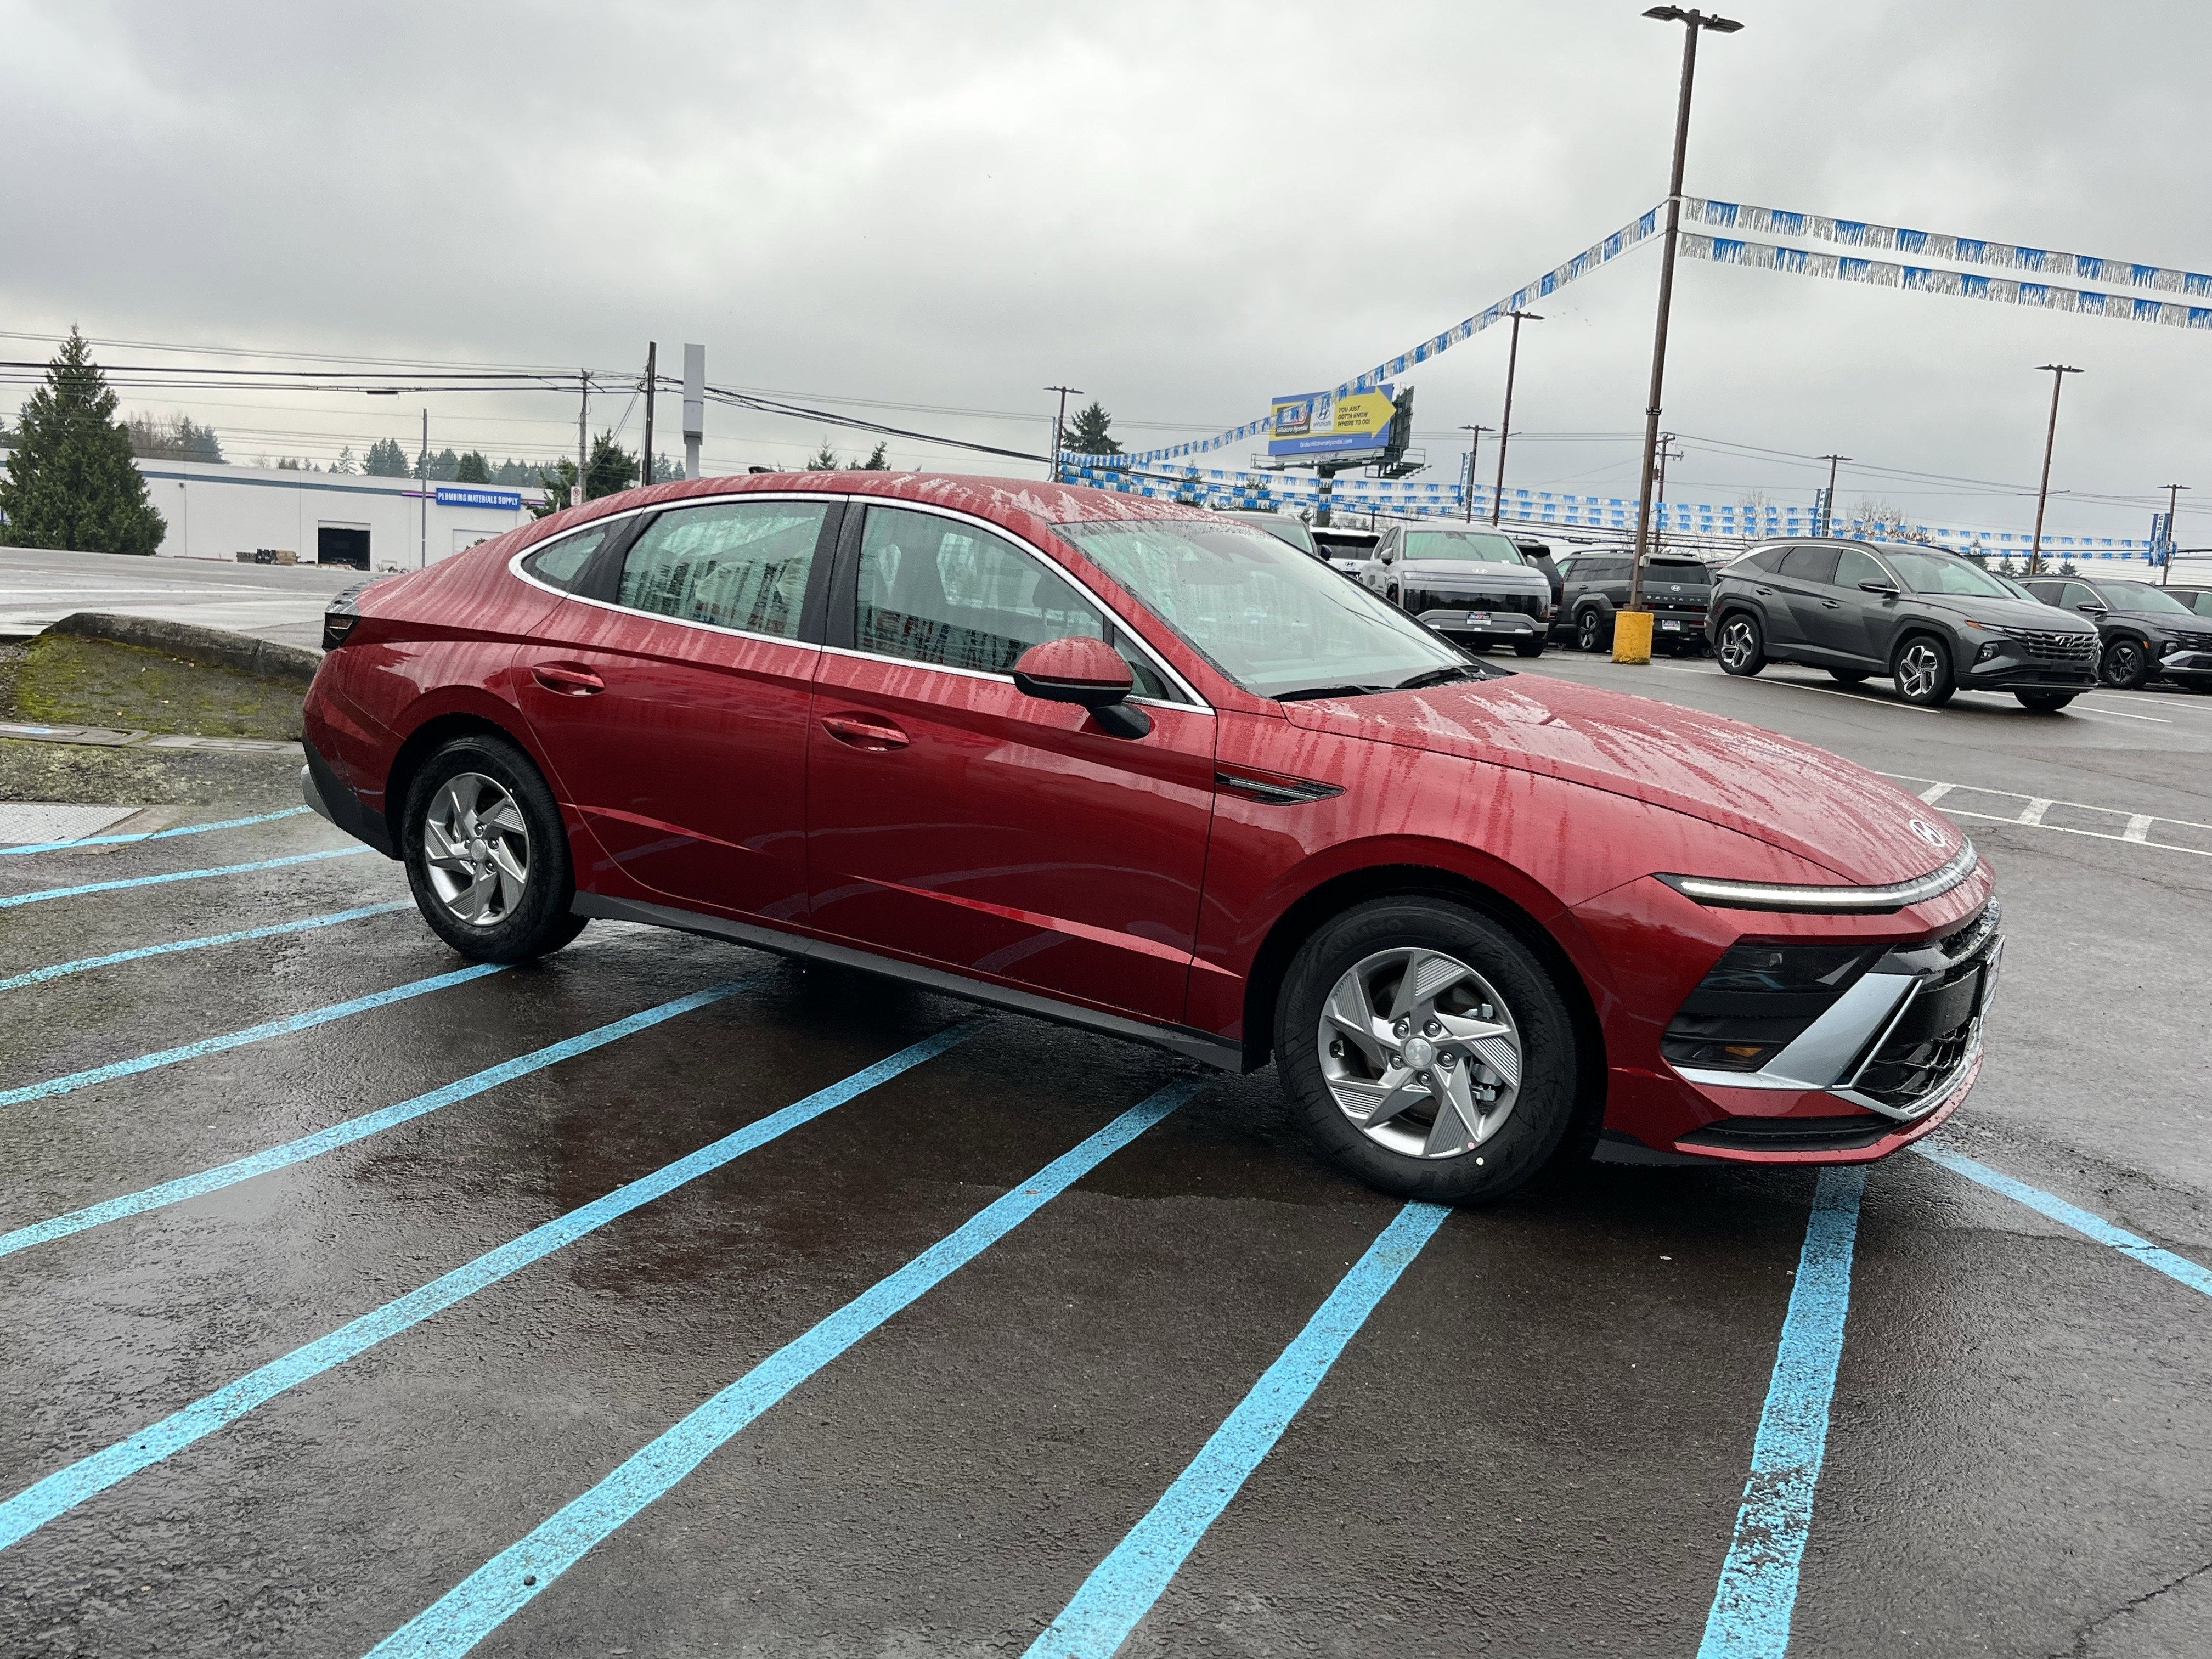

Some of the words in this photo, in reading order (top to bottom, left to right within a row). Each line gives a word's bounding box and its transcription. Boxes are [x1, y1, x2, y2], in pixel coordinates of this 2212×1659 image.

[438, 492, 467, 501] PLUMBING
[467, 495, 497, 504] MATERIALS
[498, 496, 518, 505] SUPPLY
